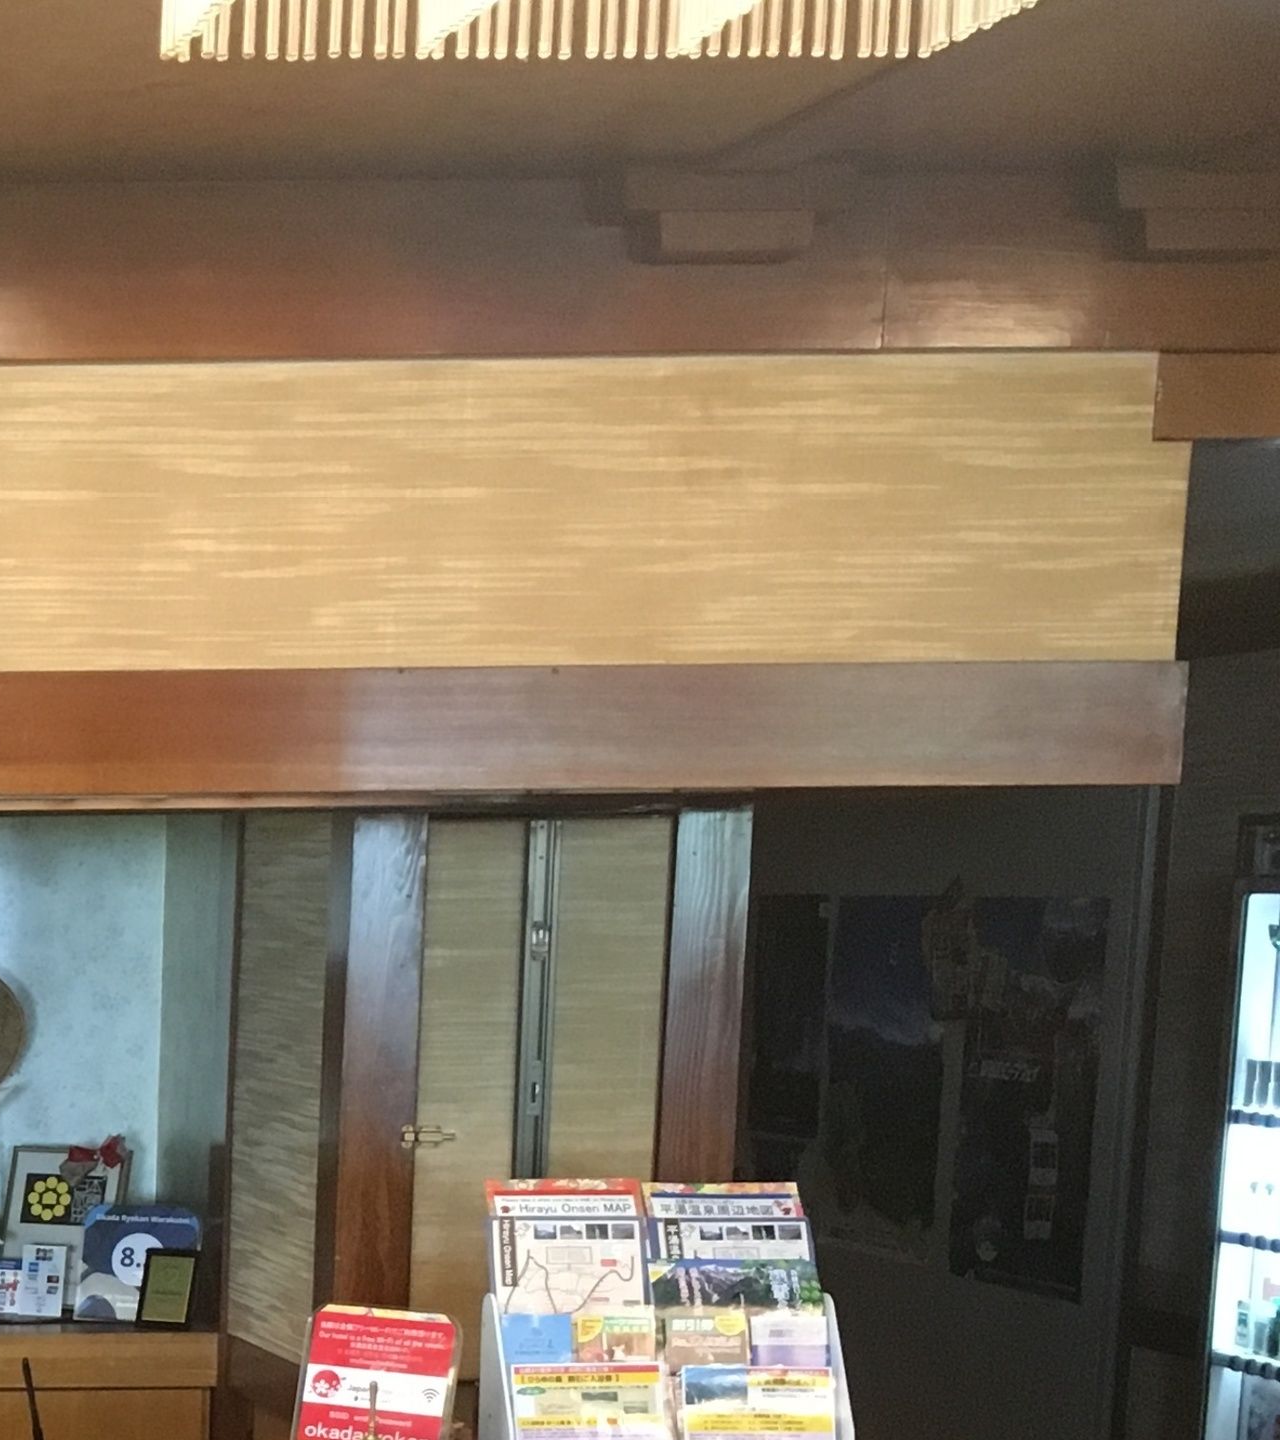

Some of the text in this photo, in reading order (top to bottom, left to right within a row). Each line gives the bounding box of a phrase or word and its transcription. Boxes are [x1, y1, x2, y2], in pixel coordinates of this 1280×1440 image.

[519, 1203, 632, 1215] Hirayu Onsen MAP
[659, 1203, 775, 1216] 平湯温泉周辺地図
